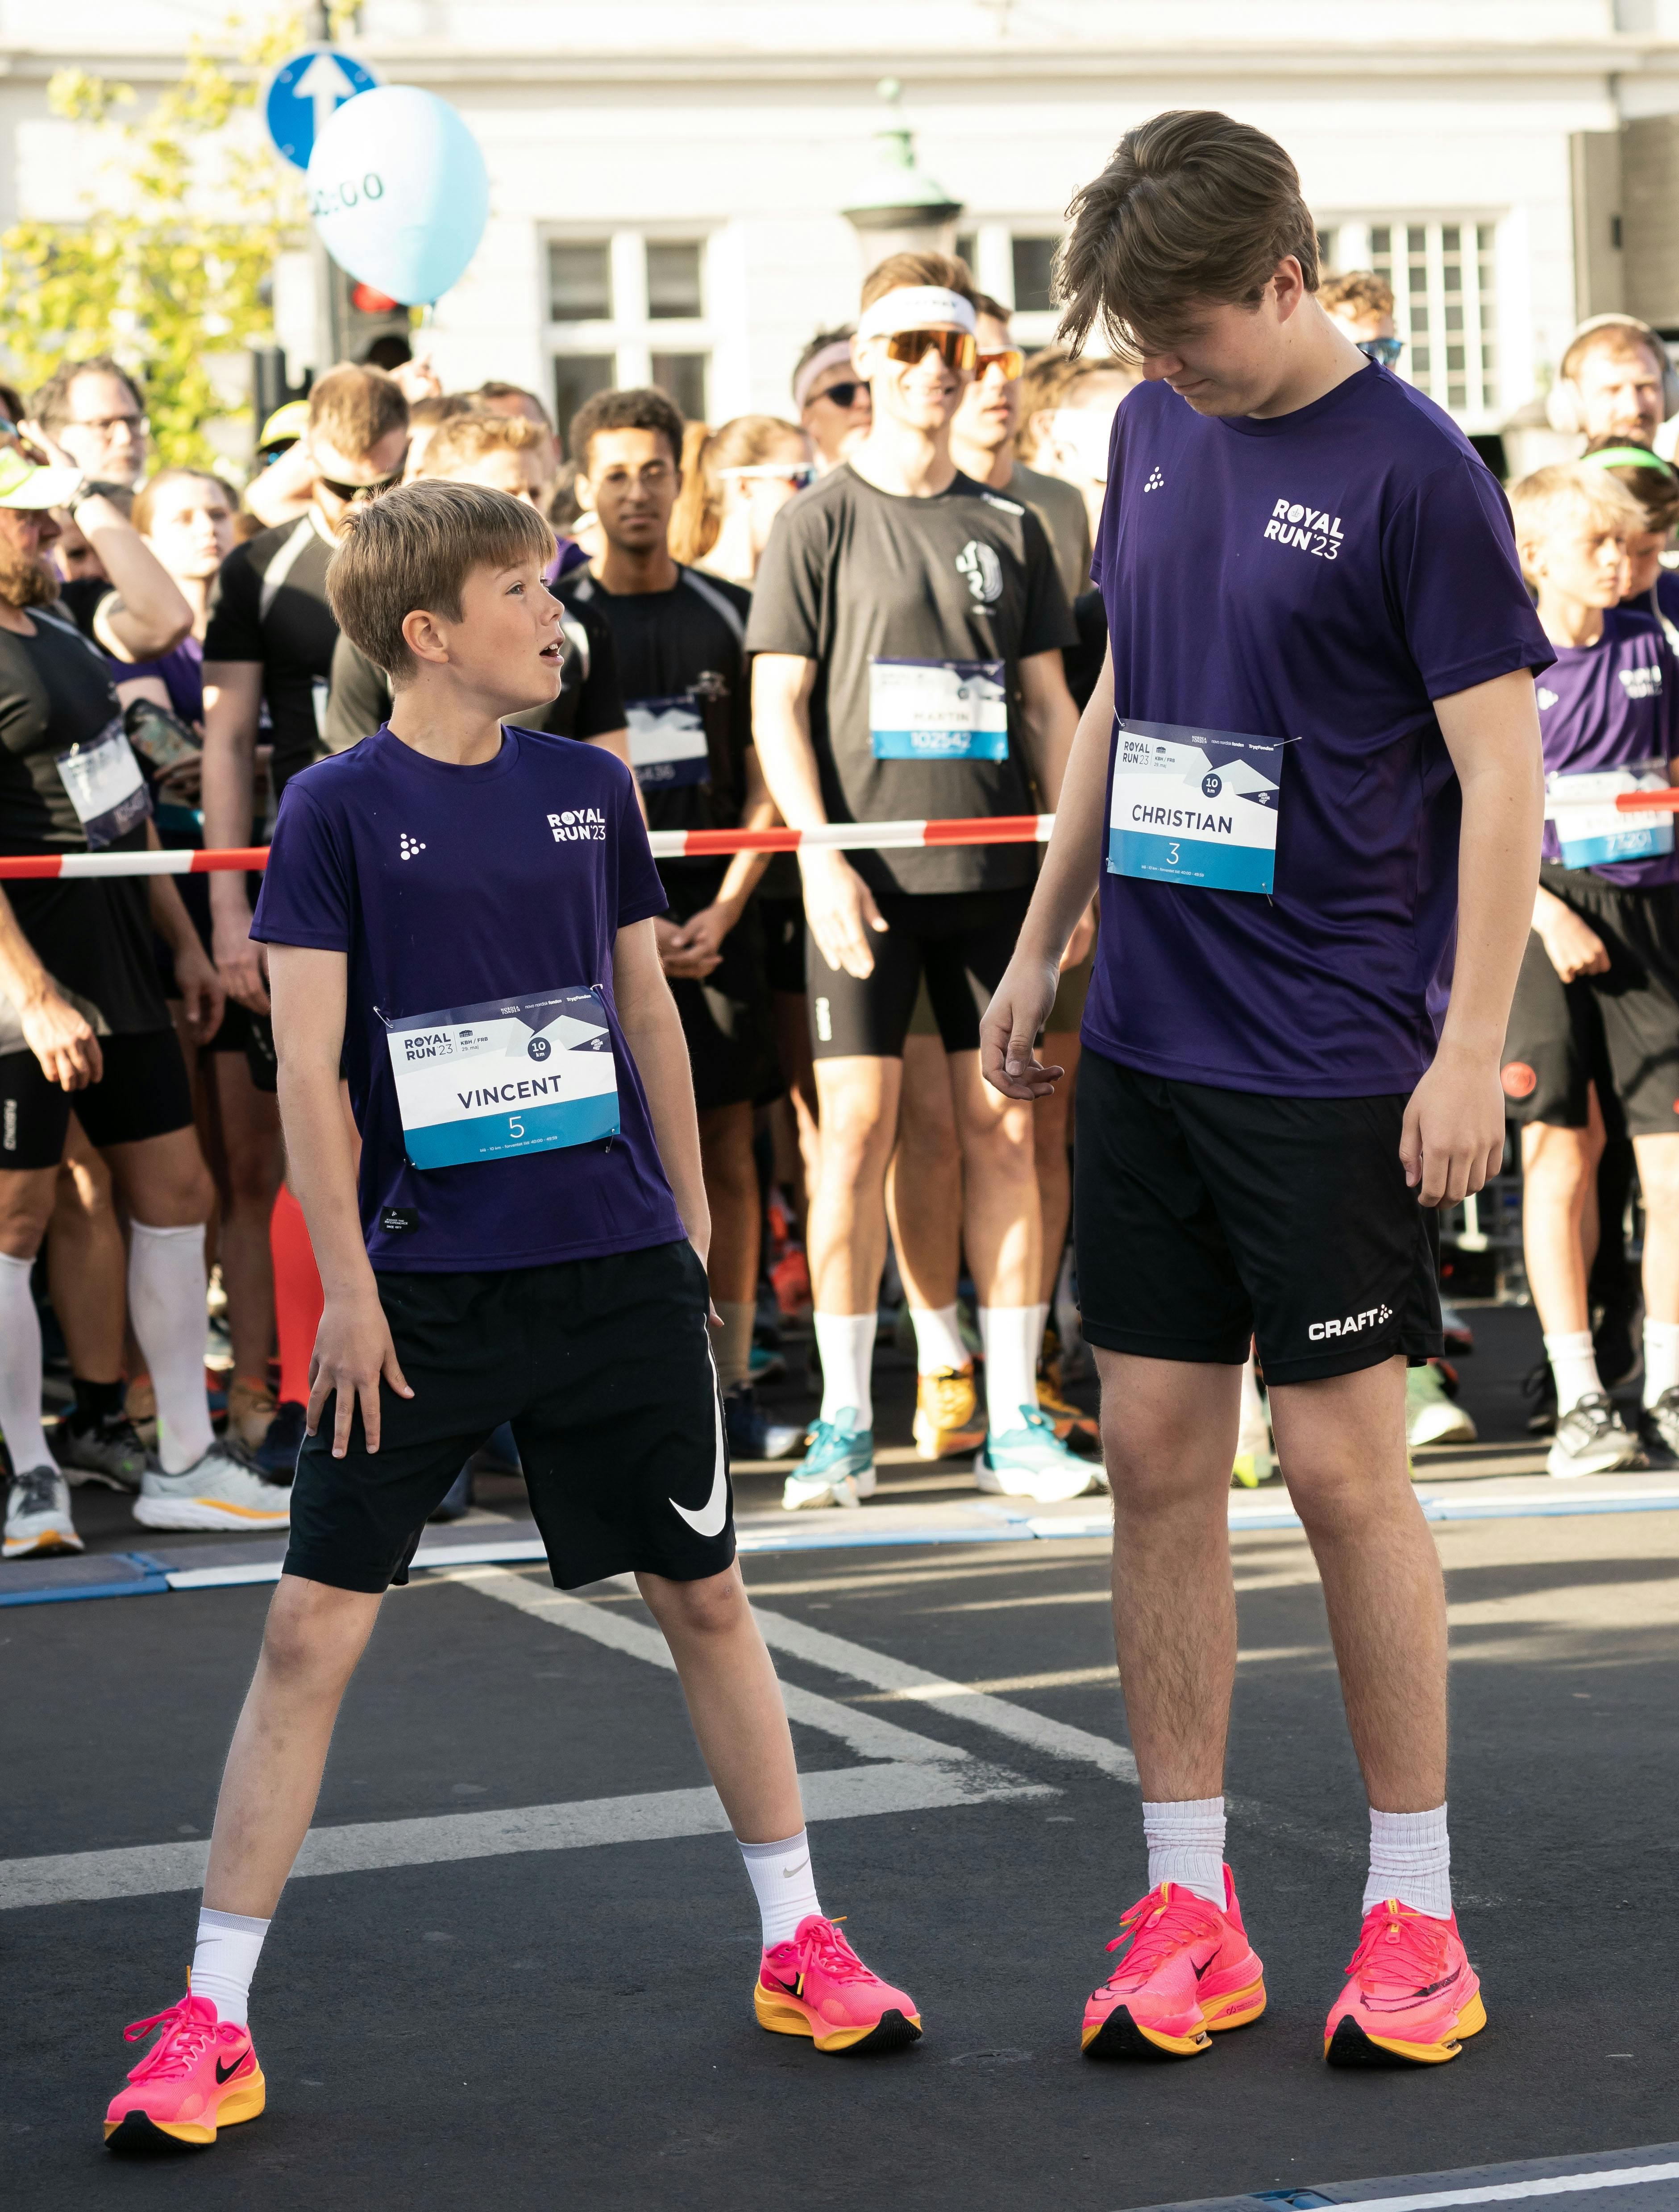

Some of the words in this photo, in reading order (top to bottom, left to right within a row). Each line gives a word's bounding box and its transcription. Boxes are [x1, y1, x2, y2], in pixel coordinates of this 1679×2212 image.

[1272, 498, 1344, 540] ROYAL
[1124, 741, 1150, 754] ROYAL
[1205, 778, 1218, 788] 10
[547, 808, 605, 827] ROYAL
[1132, 804, 1233, 834] CHRISTIAN
[1166, 842, 1180, 864] 3
[566, 994, 592, 1002] TrygFonden
[404, 1033, 451, 1049] ROYAL
[532, 1042, 546, 1052] 10
[457, 1075, 561, 1109] VINCENT
[509, 1116, 524, 1138] 5
[1309, 1308, 1378, 1340] CRAFT
